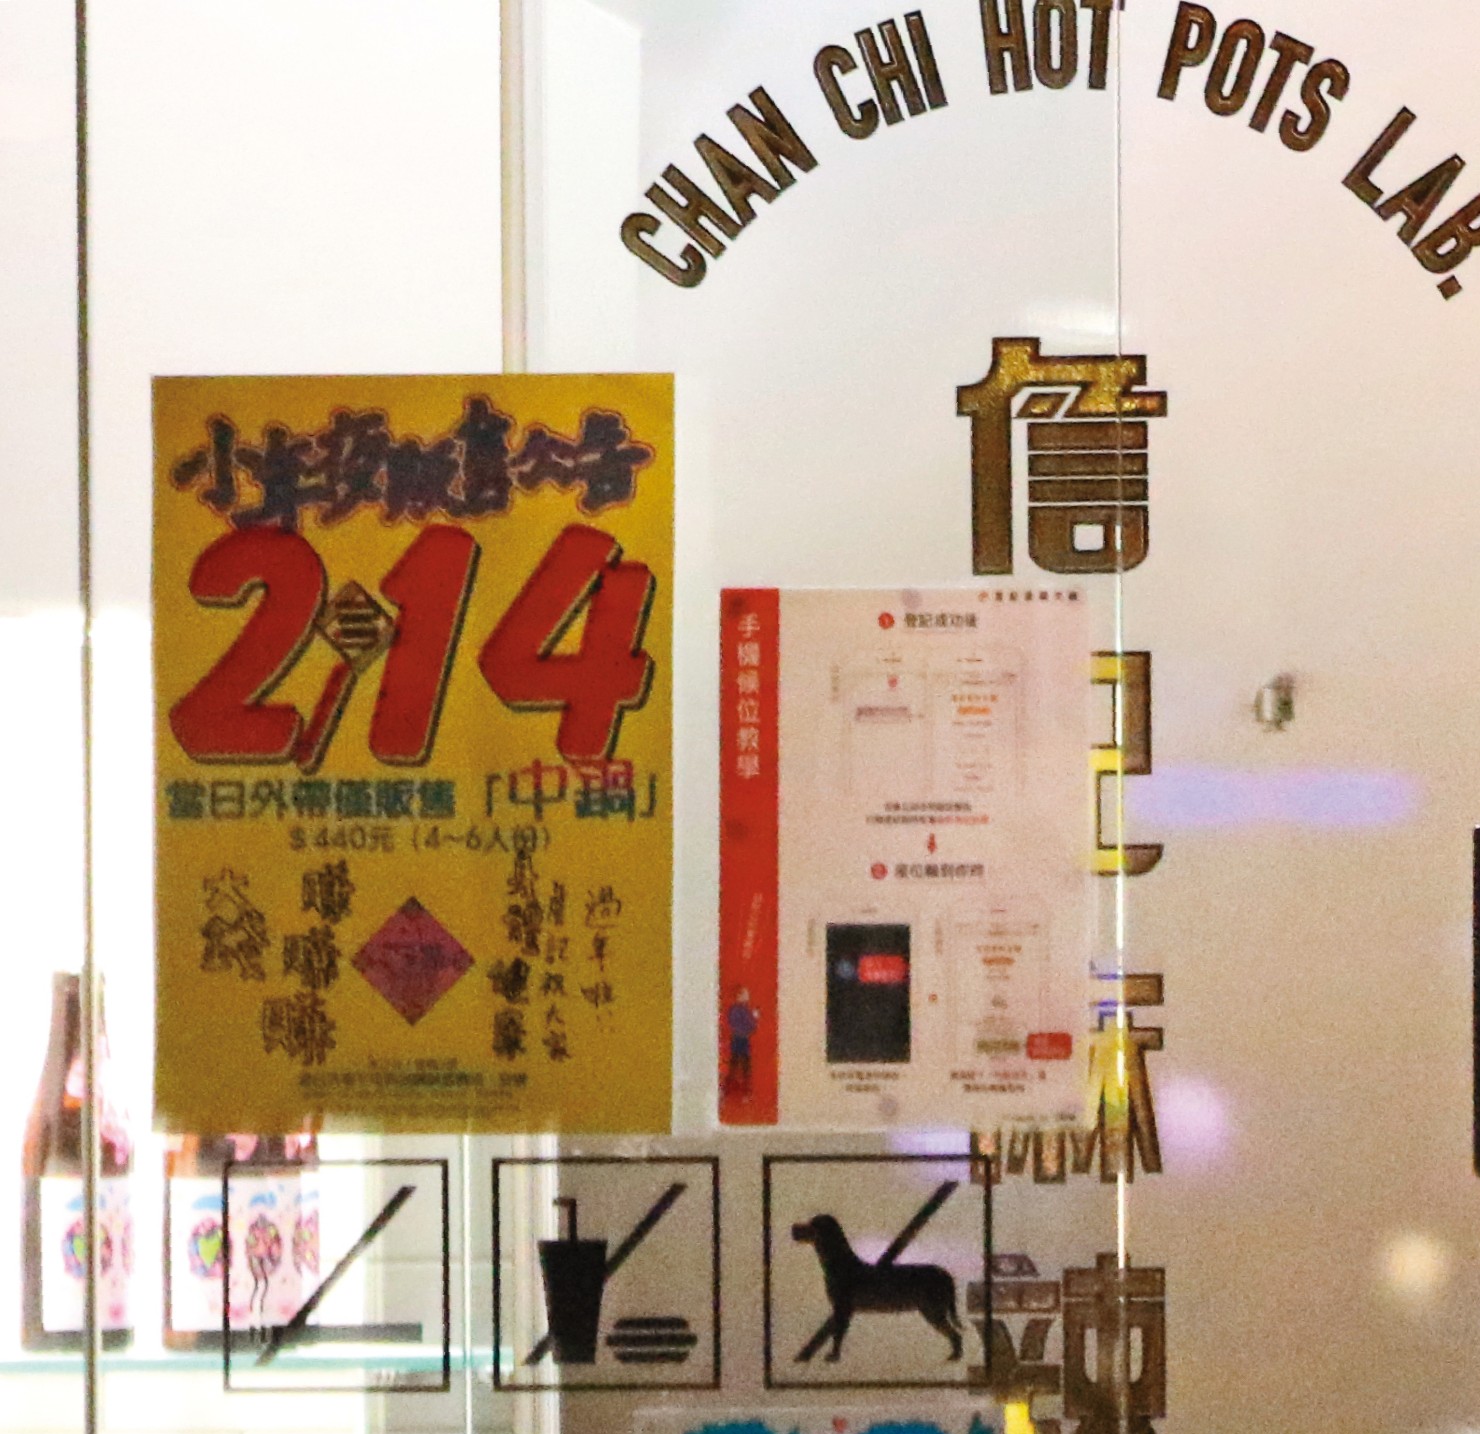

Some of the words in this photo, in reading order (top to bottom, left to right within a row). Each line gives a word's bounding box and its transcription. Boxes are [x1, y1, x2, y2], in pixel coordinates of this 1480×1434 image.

[619, 85, 821, 290] CHAN
[812, 9, 949, 141] CHI
[978, 0, 1121, 96] HOT
[1157, 0, 1351, 153] POTS
